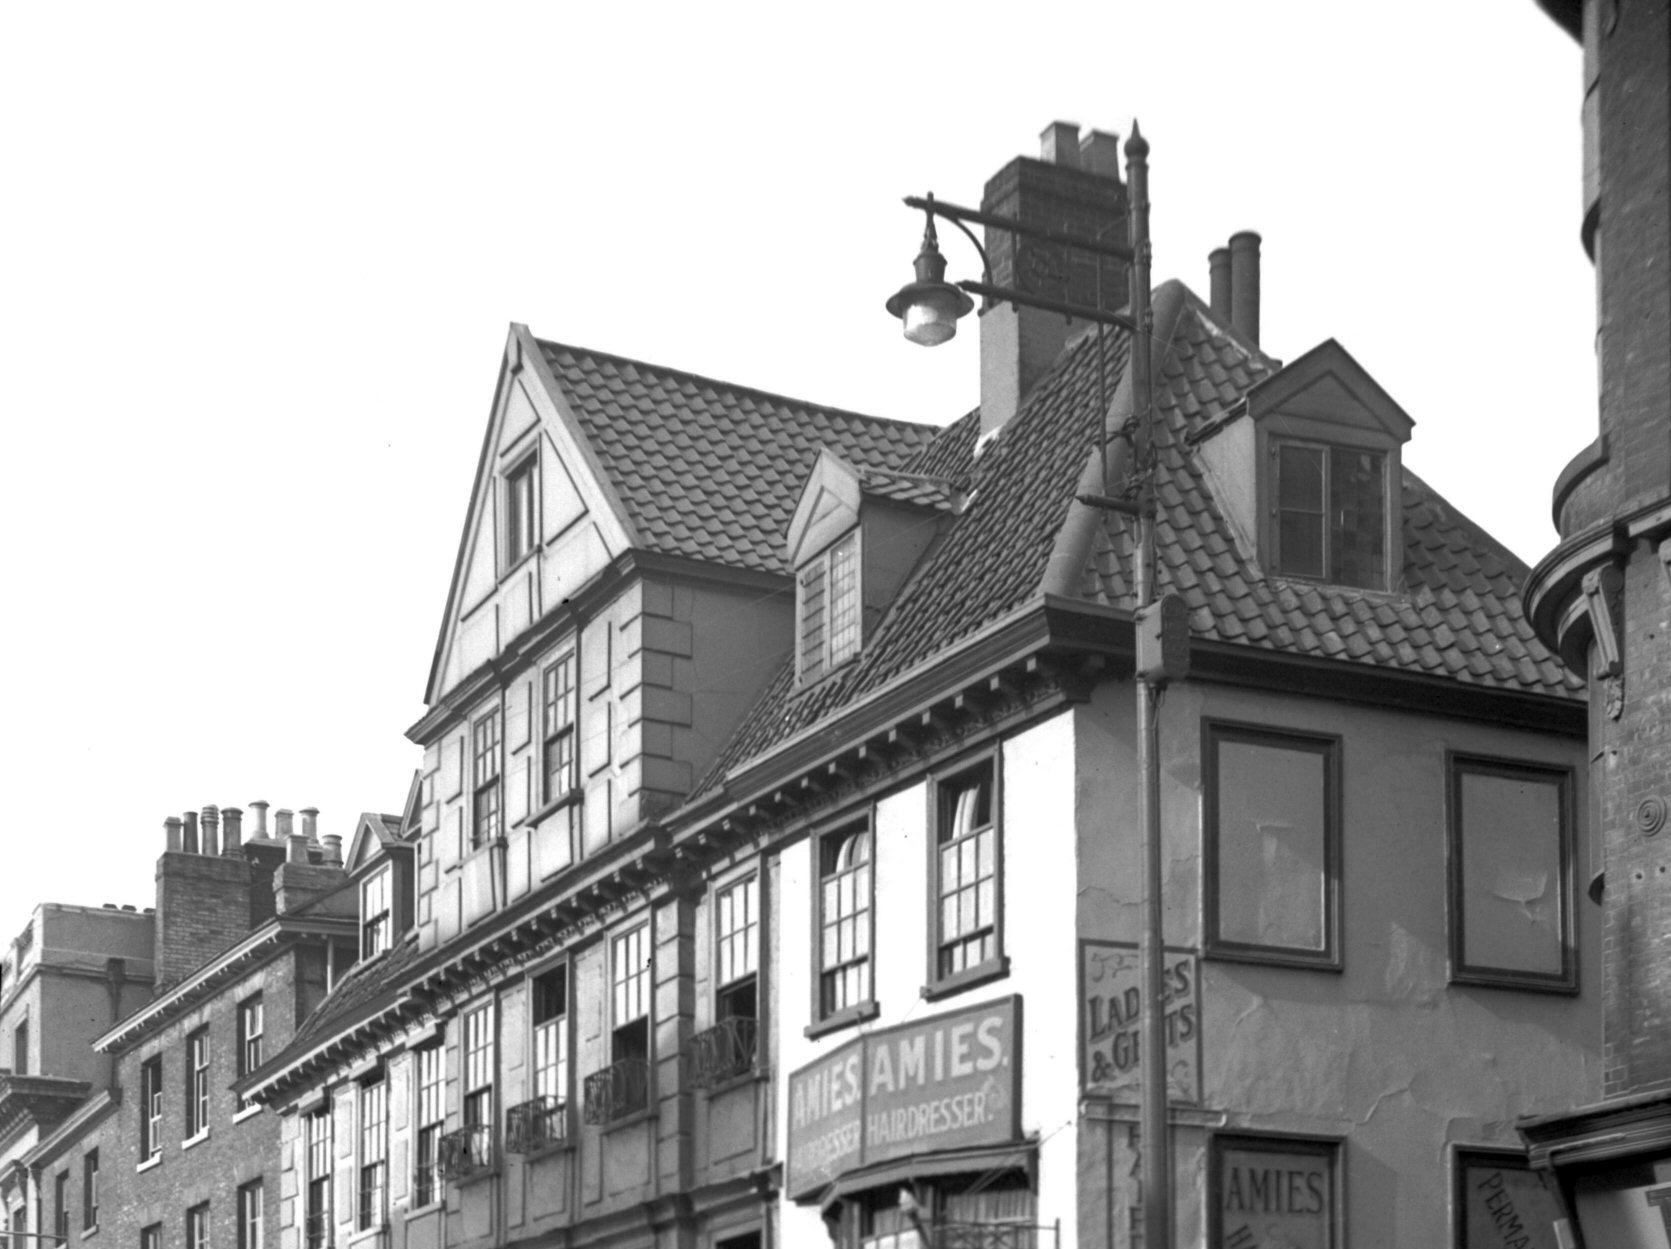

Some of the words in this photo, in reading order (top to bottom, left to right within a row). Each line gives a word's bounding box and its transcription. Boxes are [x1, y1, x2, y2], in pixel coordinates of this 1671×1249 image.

[1089, 959, 1191, 1043] LADES
[869, 1016, 1009, 1096] AMIES.
[1091, 1050, 1114, 1083] &
[1112, 1003, 1194, 1073] GTS
[793, 1053, 861, 1130] AMIES.
[867, 1091, 993, 1148] HAIRDRESSER.
[1226, 1167, 1323, 1214] AMIES
